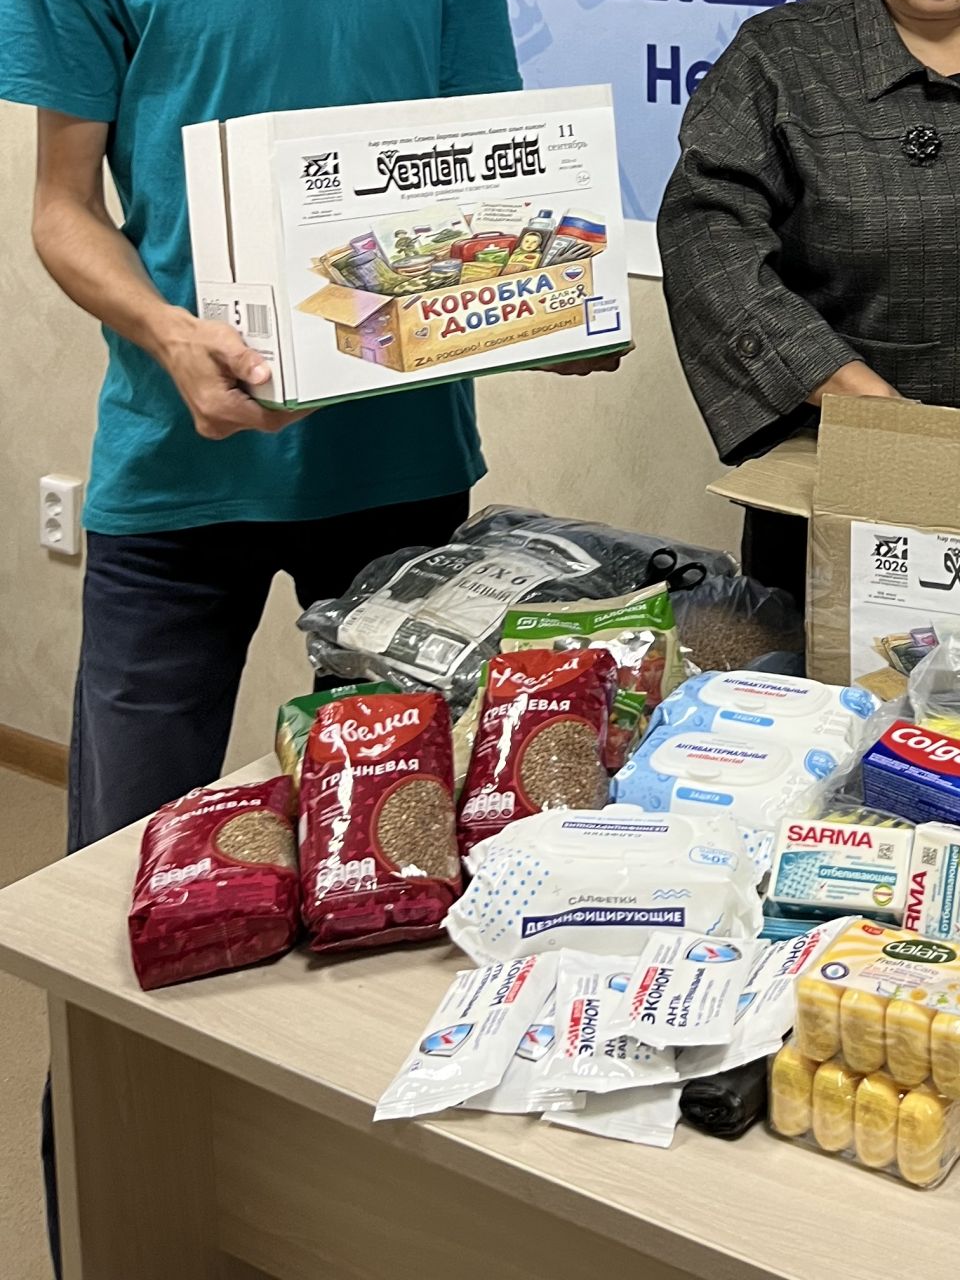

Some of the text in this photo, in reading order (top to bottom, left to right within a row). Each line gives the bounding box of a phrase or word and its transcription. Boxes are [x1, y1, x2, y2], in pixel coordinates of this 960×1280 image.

[558, 124, 575, 138] 11
[305, 177, 342, 191] 2026
[421, 273, 554, 321] КОРОБКА
[549, 296, 576, 311] СВО
[550, 290, 571, 302] ДЛЯ
[441, 299, 534, 338] ДОБРА
[517, 330, 530, 340] НЕ
[875, 558, 908, 573] 2026
[723, 677, 809, 695] АНТИБАКТЕРИАЛЬНЫЕ
[483, 699, 571, 724] ГРЕЕВАЯ
[675, 742, 768, 760] АНТИБАКТЕРИАЛЬНЫЕ
[321, 758, 420, 791] ГРЧНЕВАЯ
[787, 825, 873, 849] SARMA
[820, 868, 898, 884] отбеливающее
[568, 894, 638, 906] САЛФЕТКИ
[904, 871, 927, 933] RMA
[524, 909, 683, 936] ДЕЗИНФИЦИРУЮЩИЕ
[886, 940, 950, 963] dalan
[489, 959, 524, 1007] КОНОМ
[640, 967, 674, 1025] ЭКОНОМ
[579, 997, 601, 1057] ЭКОНОМ
